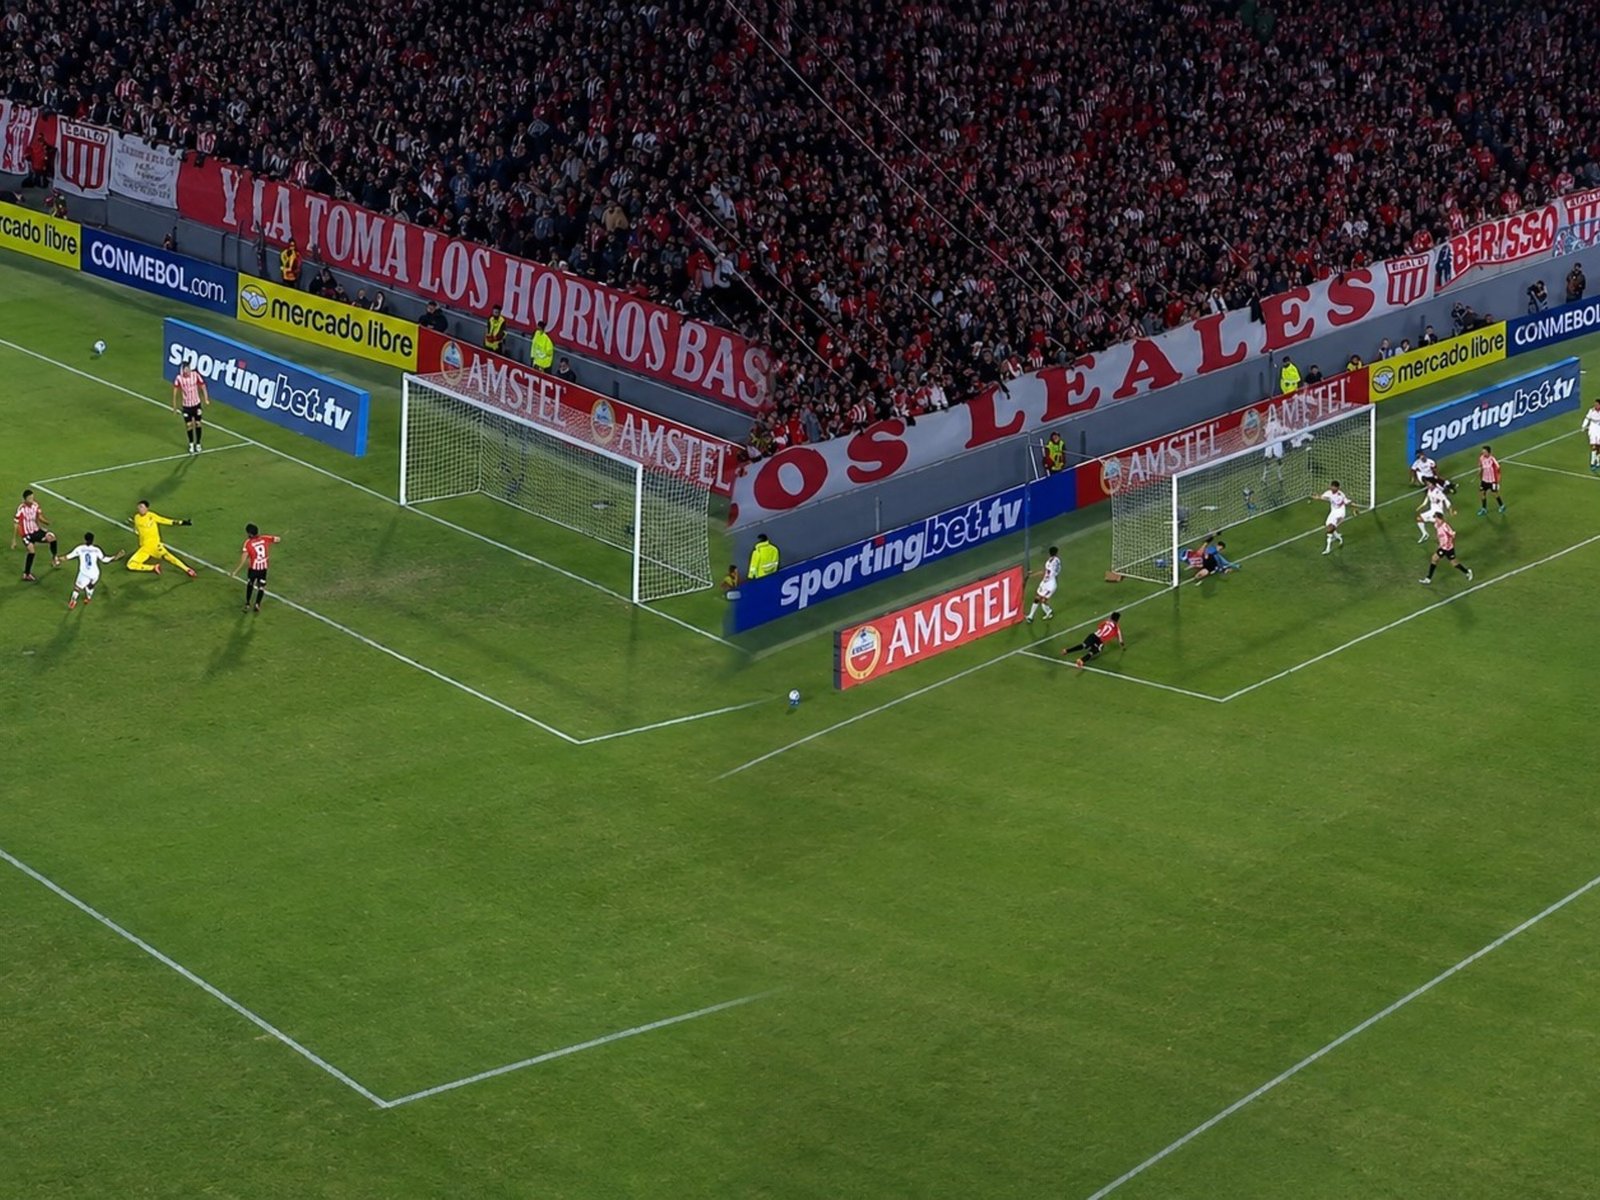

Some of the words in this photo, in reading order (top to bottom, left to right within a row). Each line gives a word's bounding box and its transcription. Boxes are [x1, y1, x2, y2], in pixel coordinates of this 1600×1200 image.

[0, 215, 41, 243] cado
[44, 222, 77, 255] libre
[220, 166, 243, 226] Y
[251, 178, 293, 243] LA
[305, 194, 409, 283] TOMA
[418, 229, 491, 309] LOS
[502, 257, 669, 372] HORNOS
[1450, 204, 1559, 276] BERISSO
[271, 298, 363, 343] mercado
[367, 319, 413, 357] libre
[964, 270, 1375, 450] LEALES
[1398, 342, 1469, 383] mercado
[1471, 333, 1504, 360] libre
[467, 353, 567, 427] AMSTEL
[1420, 378, 1575, 451] sportingbet.tv
[619, 413, 731, 490] AMSTEL
[1128, 423, 1222, 486] AMSTEL
[781, 497, 1023, 610] sportingbet.tv
[885, 577, 1018, 666] AMSTEL
